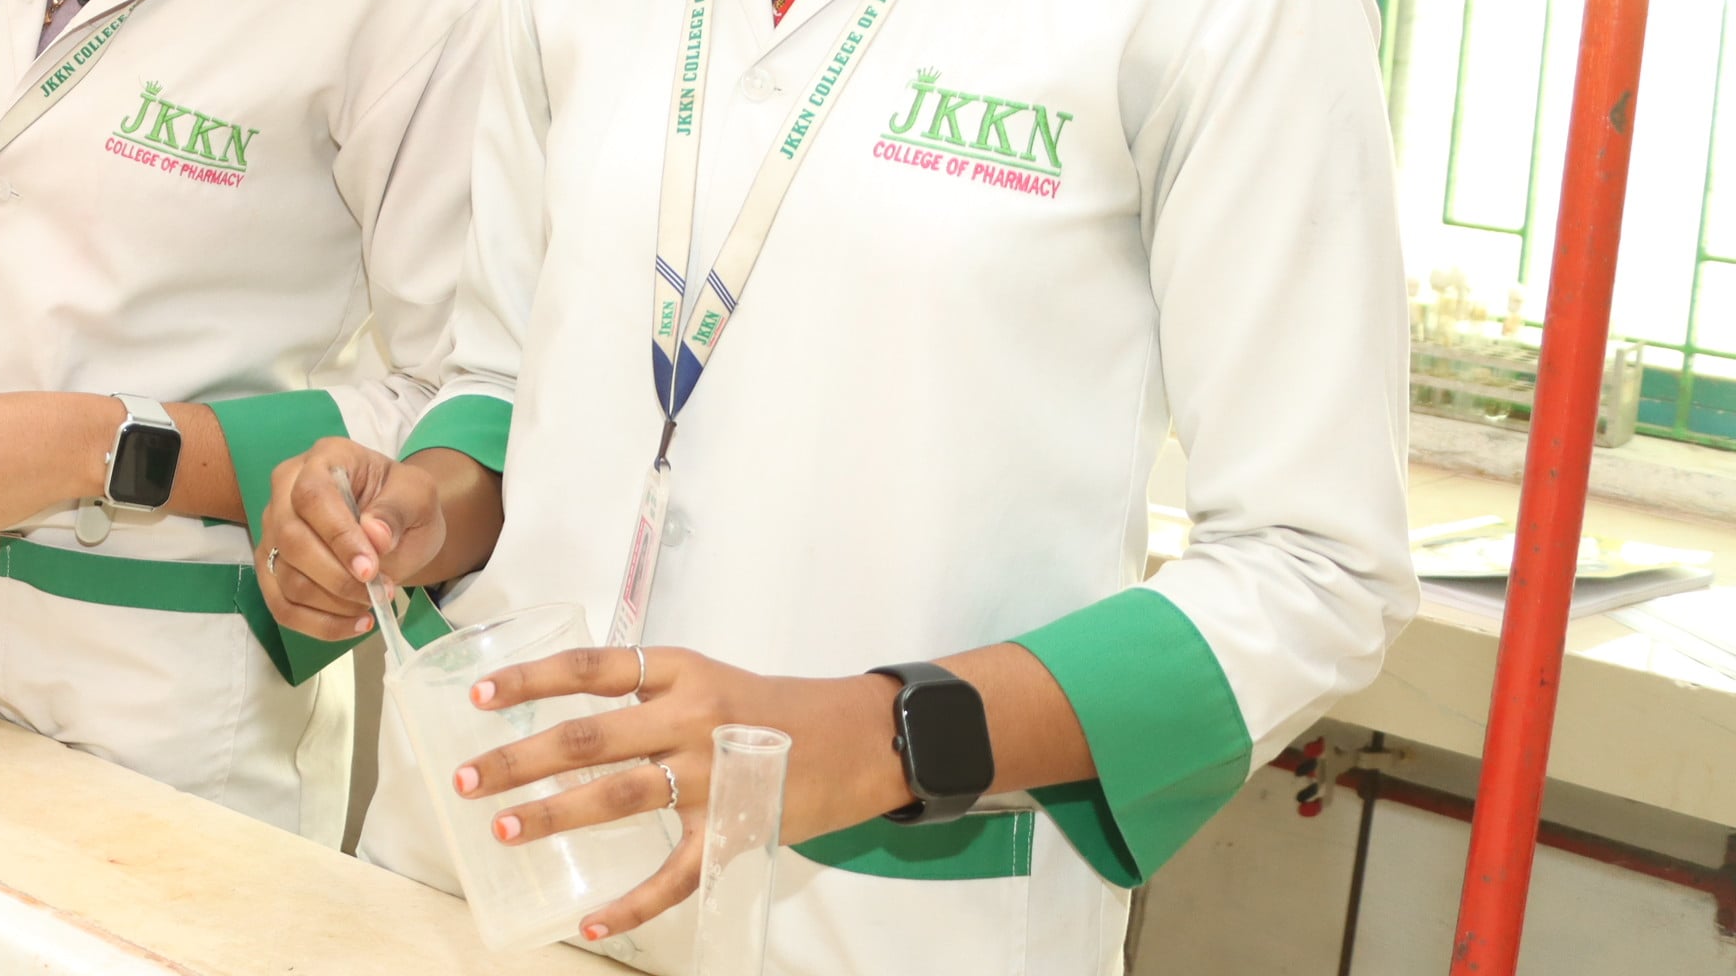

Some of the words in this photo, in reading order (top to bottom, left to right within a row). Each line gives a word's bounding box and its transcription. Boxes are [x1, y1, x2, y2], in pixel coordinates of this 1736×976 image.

[39, 61, 76, 99] JKKN
[72, 13, 128, 66] COLLEGE
[683, 6, 705, 84] COLLEGE
[676, 88, 696, 137] JKKN
[779, 108, 815, 161] JKKN
[808, 30, 864, 107] COLLEGE
[857, 4, 879, 30] OF
[119, 92, 262, 167] JKKN
[888, 81, 1075, 170] JKKN
[104, 137, 161, 168] COLLEGE
[160, 156, 180, 175] OF
[179, 163, 246, 189] PHARMACY
[872, 140, 944, 172] COLLEGE
[945, 157, 970, 178] OF
[970, 162, 1062, 200] PHARMACY
[658, 300, 674, 337] JKKN
[691, 309, 722, 346] JKKN
